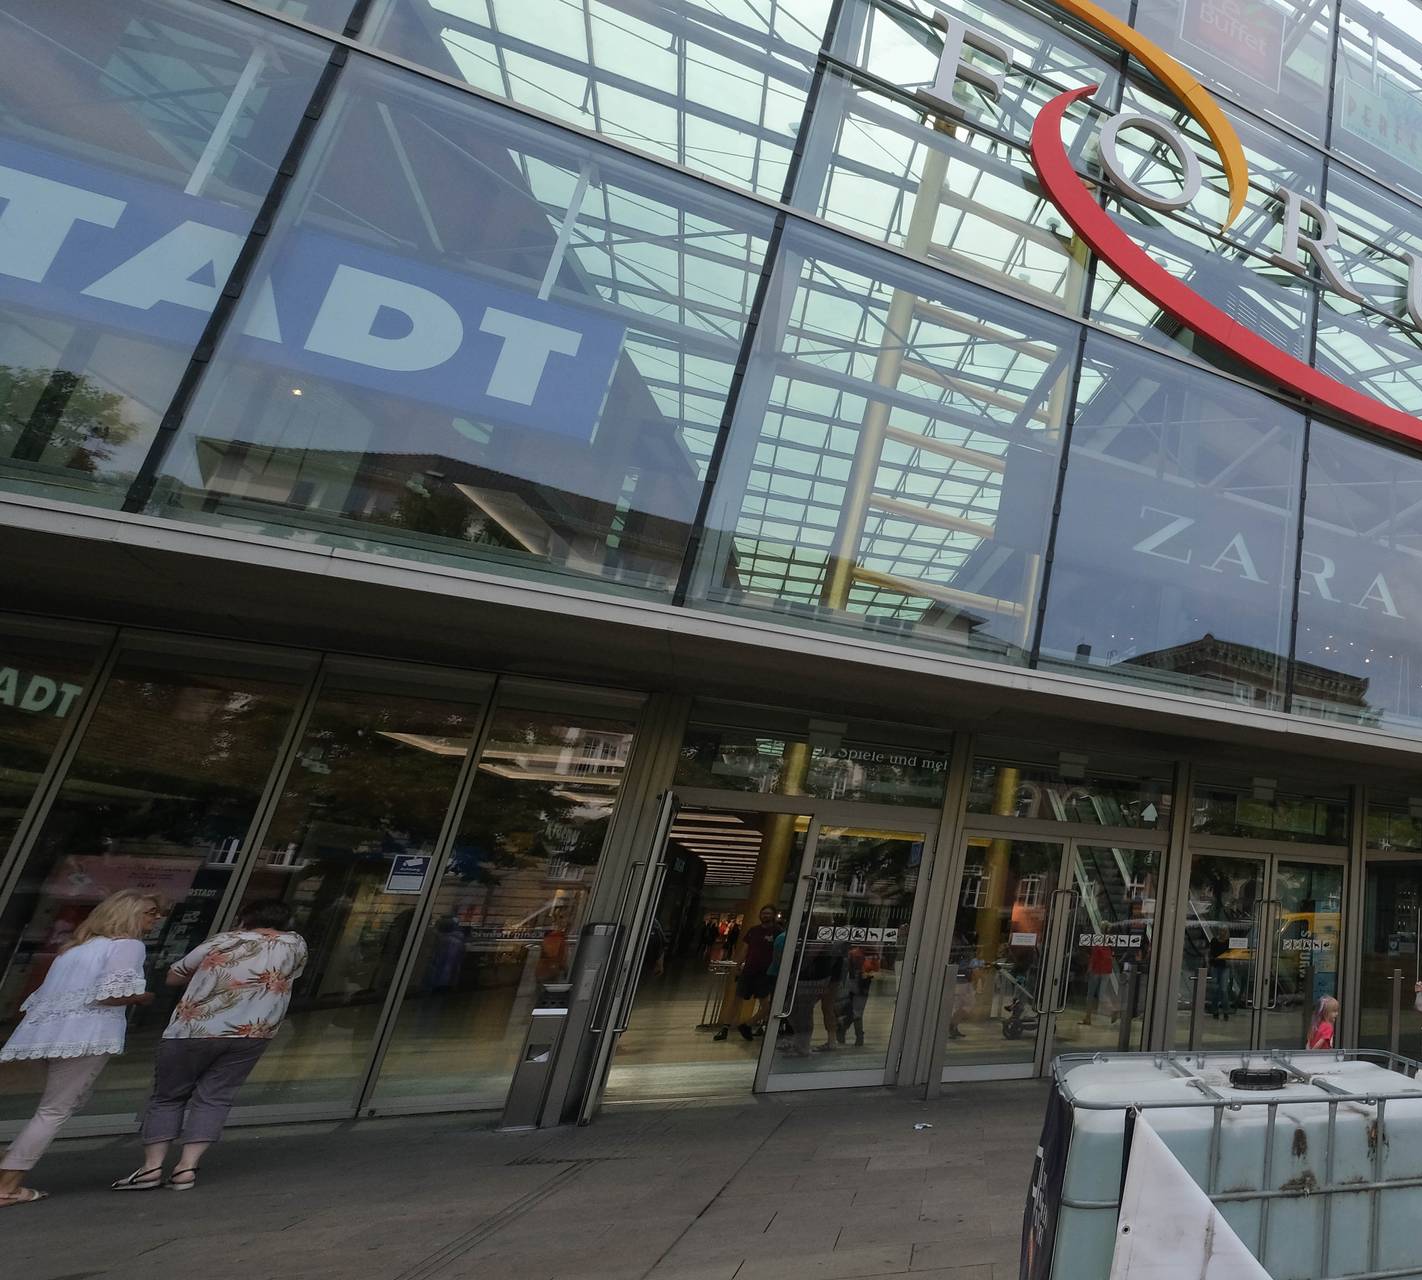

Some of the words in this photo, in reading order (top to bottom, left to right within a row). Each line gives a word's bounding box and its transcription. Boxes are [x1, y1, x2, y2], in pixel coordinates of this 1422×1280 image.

[0, 164, 583, 407] TADT
[1132, 505, 1406, 620] ZARA
[889, 754, 917, 767] und
